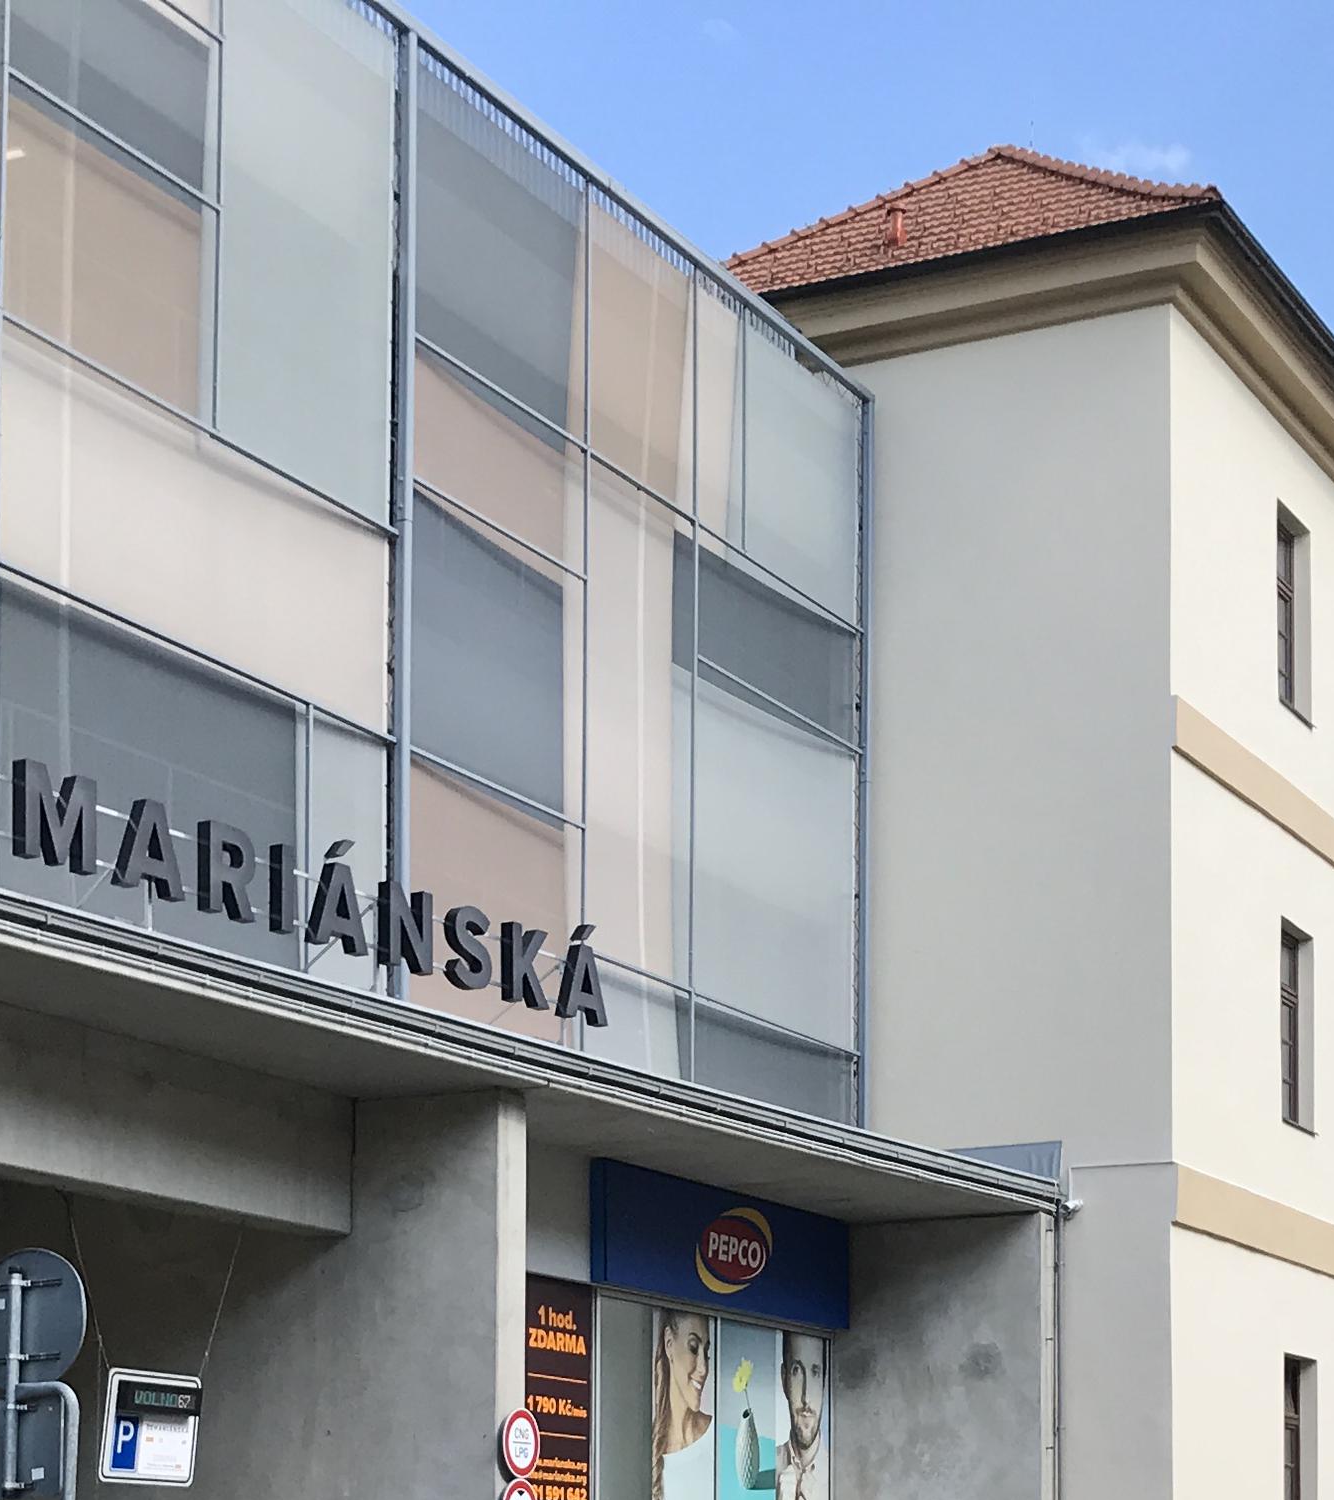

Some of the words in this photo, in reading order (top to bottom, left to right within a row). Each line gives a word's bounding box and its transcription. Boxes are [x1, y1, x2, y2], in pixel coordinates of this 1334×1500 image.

[12, 758, 608, 1027] MARIÁNSKÁ
[708, 1231, 762, 1268] PEPCO
[537, 1304, 546, 1325] 1
[548, 1306, 577, 1330] hod.
[528, 1327, 587, 1356] ZDARMA
[527, 1394, 534, 1412] 1
[535, 1395, 557, 1415] 790
[116, 1420, 135, 1454] P
[513, 1426, 530, 1440] CNG
[514, 1446, 530, 1459] LPG
